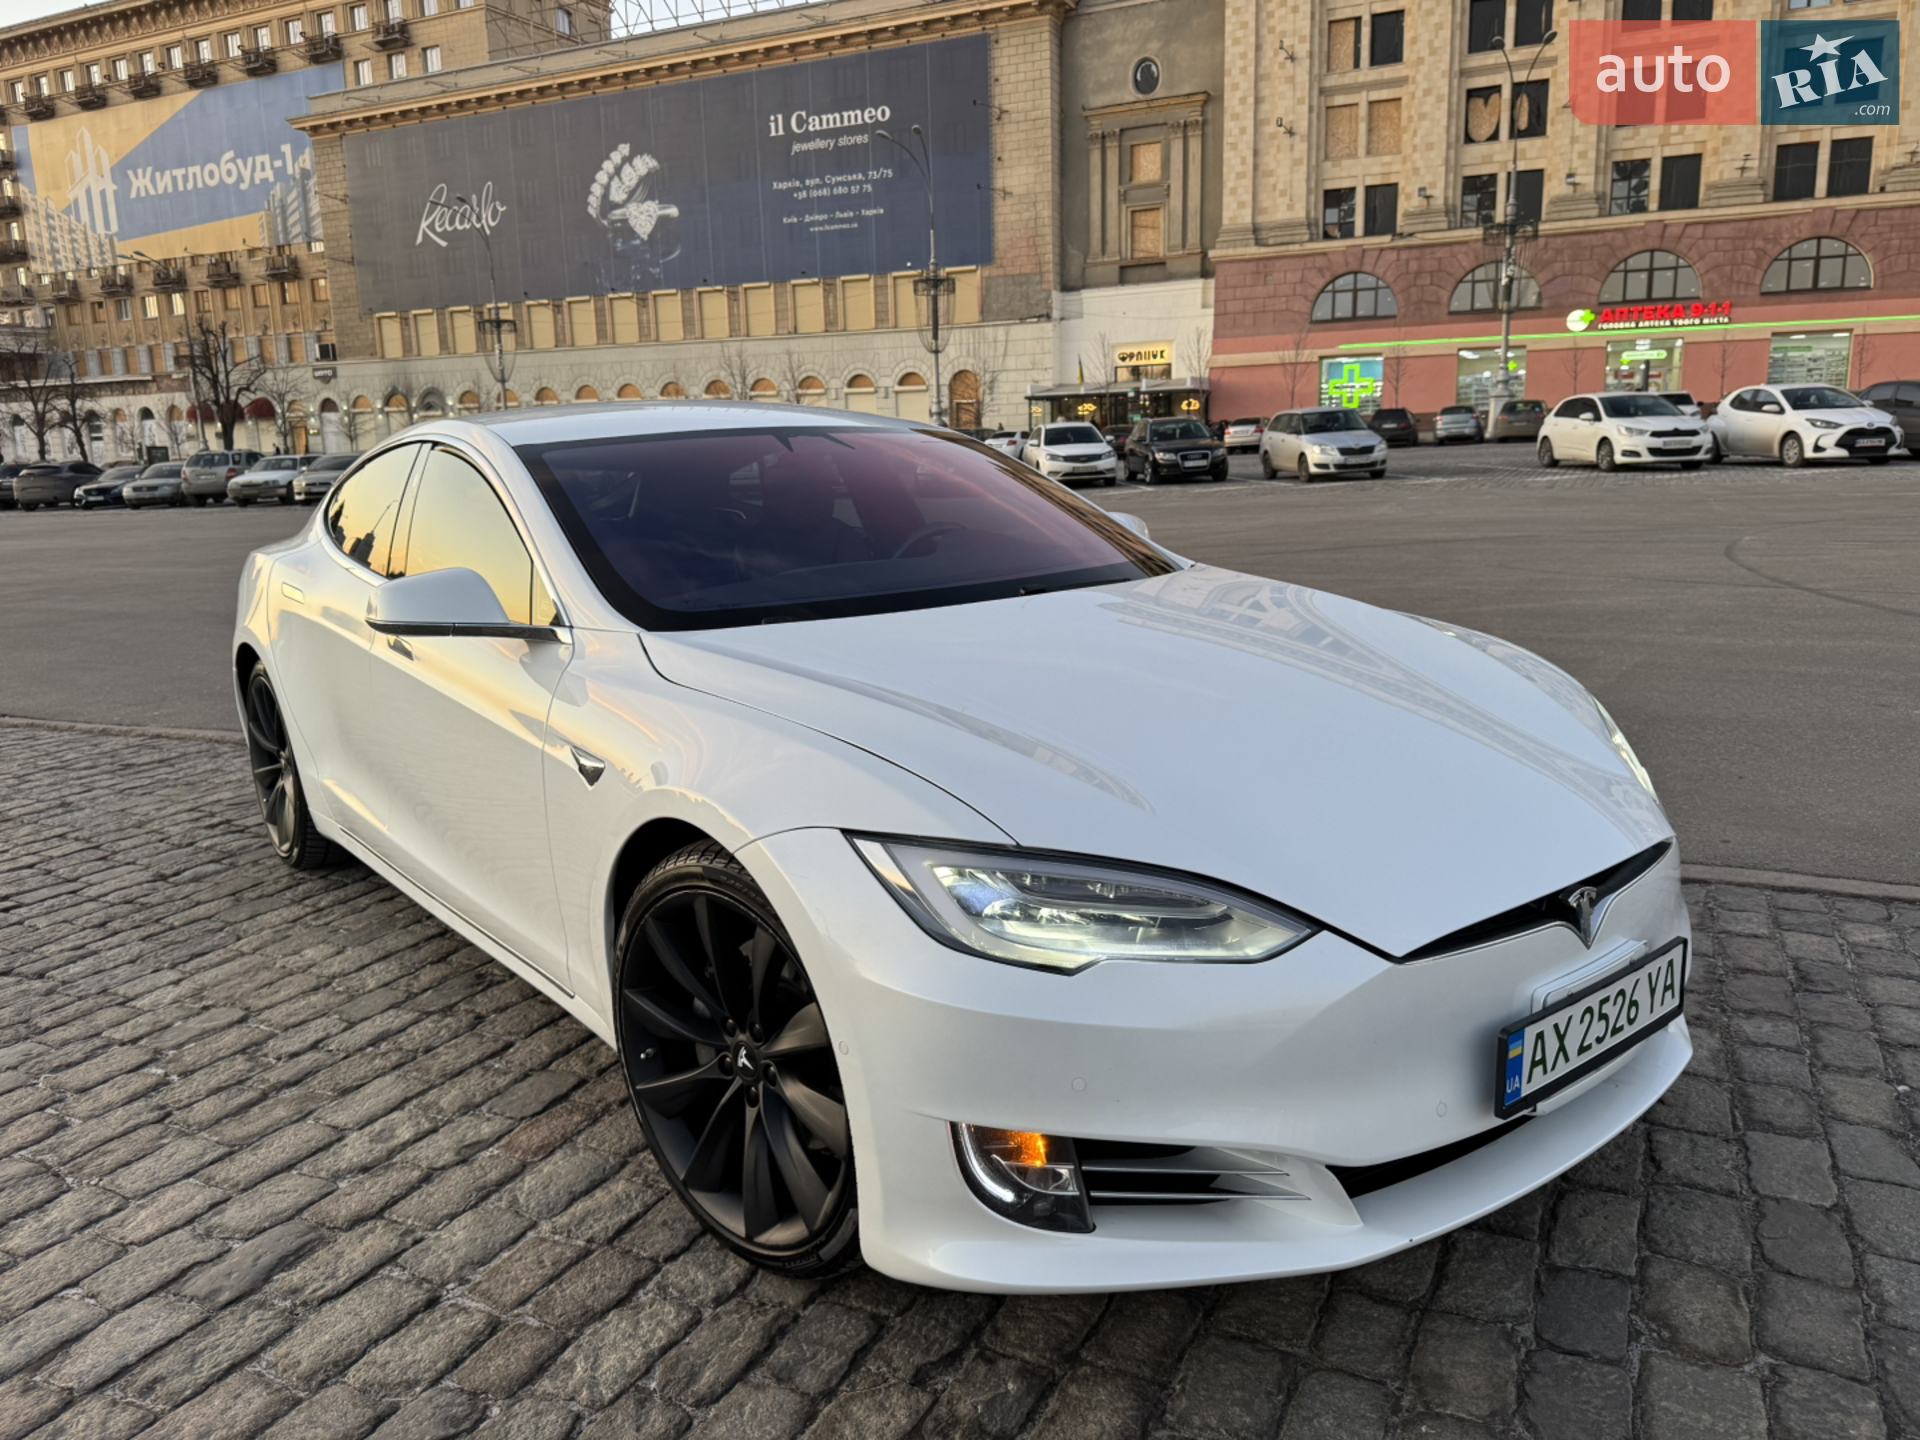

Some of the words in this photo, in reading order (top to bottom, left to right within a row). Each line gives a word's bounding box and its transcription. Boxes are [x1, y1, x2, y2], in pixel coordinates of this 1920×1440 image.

[769, 114, 785, 136] il
[790, 105, 890, 133] Cammeo
[790, 136, 836, 155] jewellery
[837, 133, 869, 146] stores
[126, 143, 295, 199] Житлобуд-1
[1600, 304, 1686, 323] АПТЕКА
[1690, 301, 1731, 318] 9-1-1
[1638, 319, 1671, 328] АПТЕКА
[1506, 1074, 1521, 1094] UA
